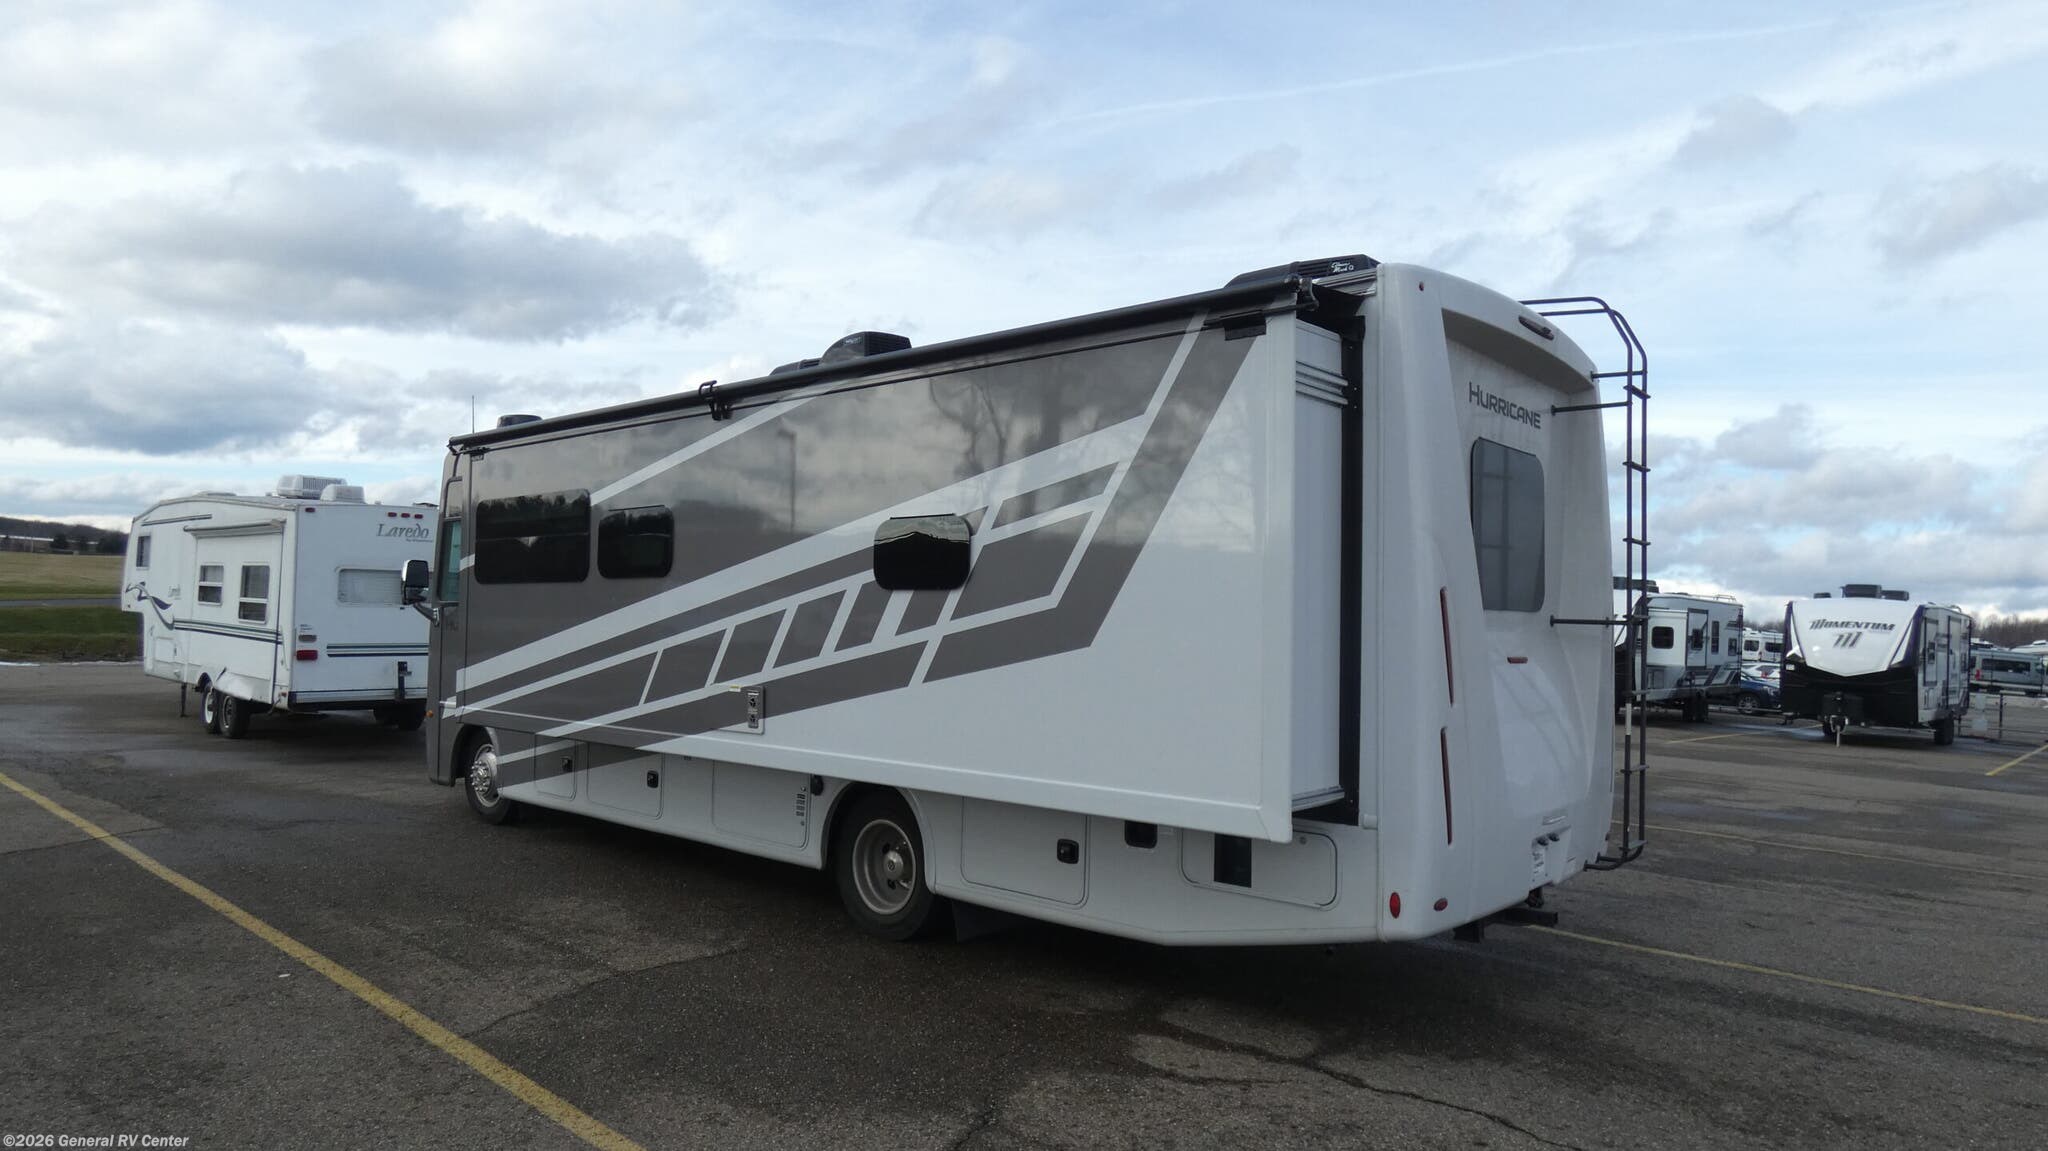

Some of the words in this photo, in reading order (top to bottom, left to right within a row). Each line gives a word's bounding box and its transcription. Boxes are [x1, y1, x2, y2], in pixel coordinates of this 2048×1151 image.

[1468, 381, 1542, 430] HURRICANE
[377, 523, 429, 538] Laredo
[1809, 619, 1896, 631] MOMENTUM
